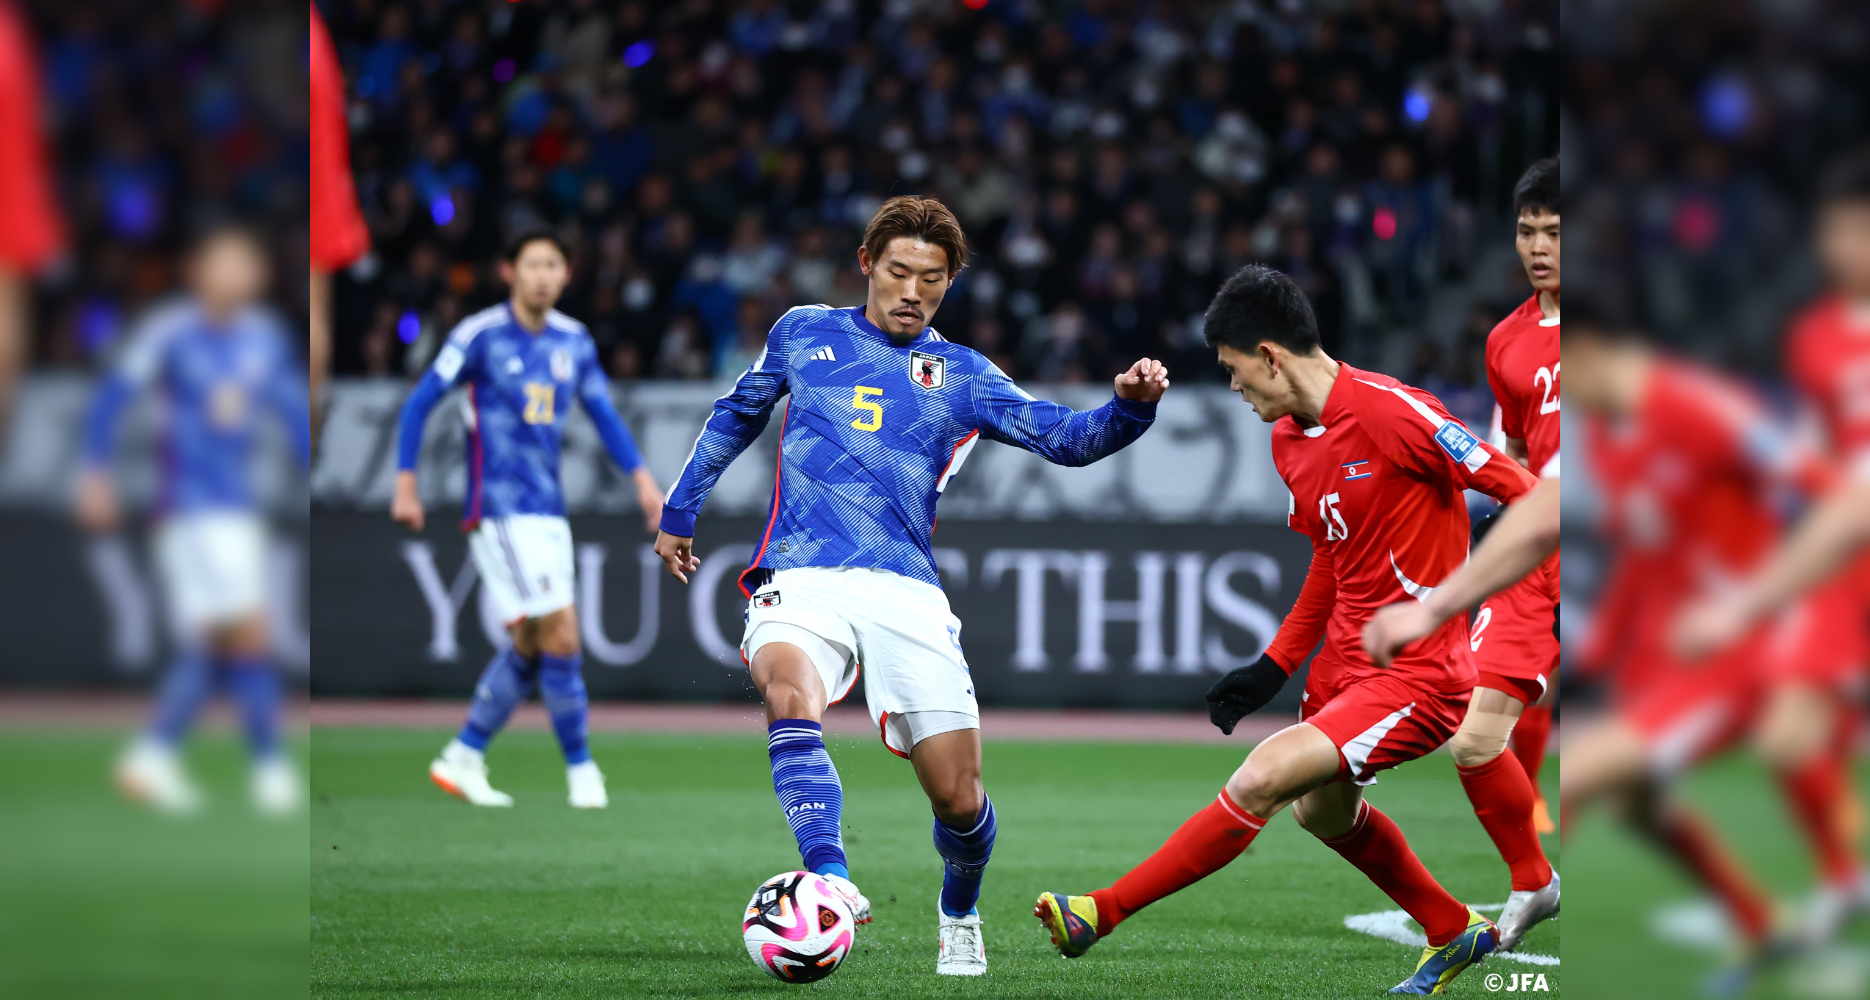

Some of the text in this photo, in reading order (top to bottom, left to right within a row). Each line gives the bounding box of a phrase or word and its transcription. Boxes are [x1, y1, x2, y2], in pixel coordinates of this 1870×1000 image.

[851, 385, 883, 432] 5
[1319, 491, 1348, 540] 15
[980, 548, 1281, 675] THIS
[1470, 607, 1492, 652] 2
